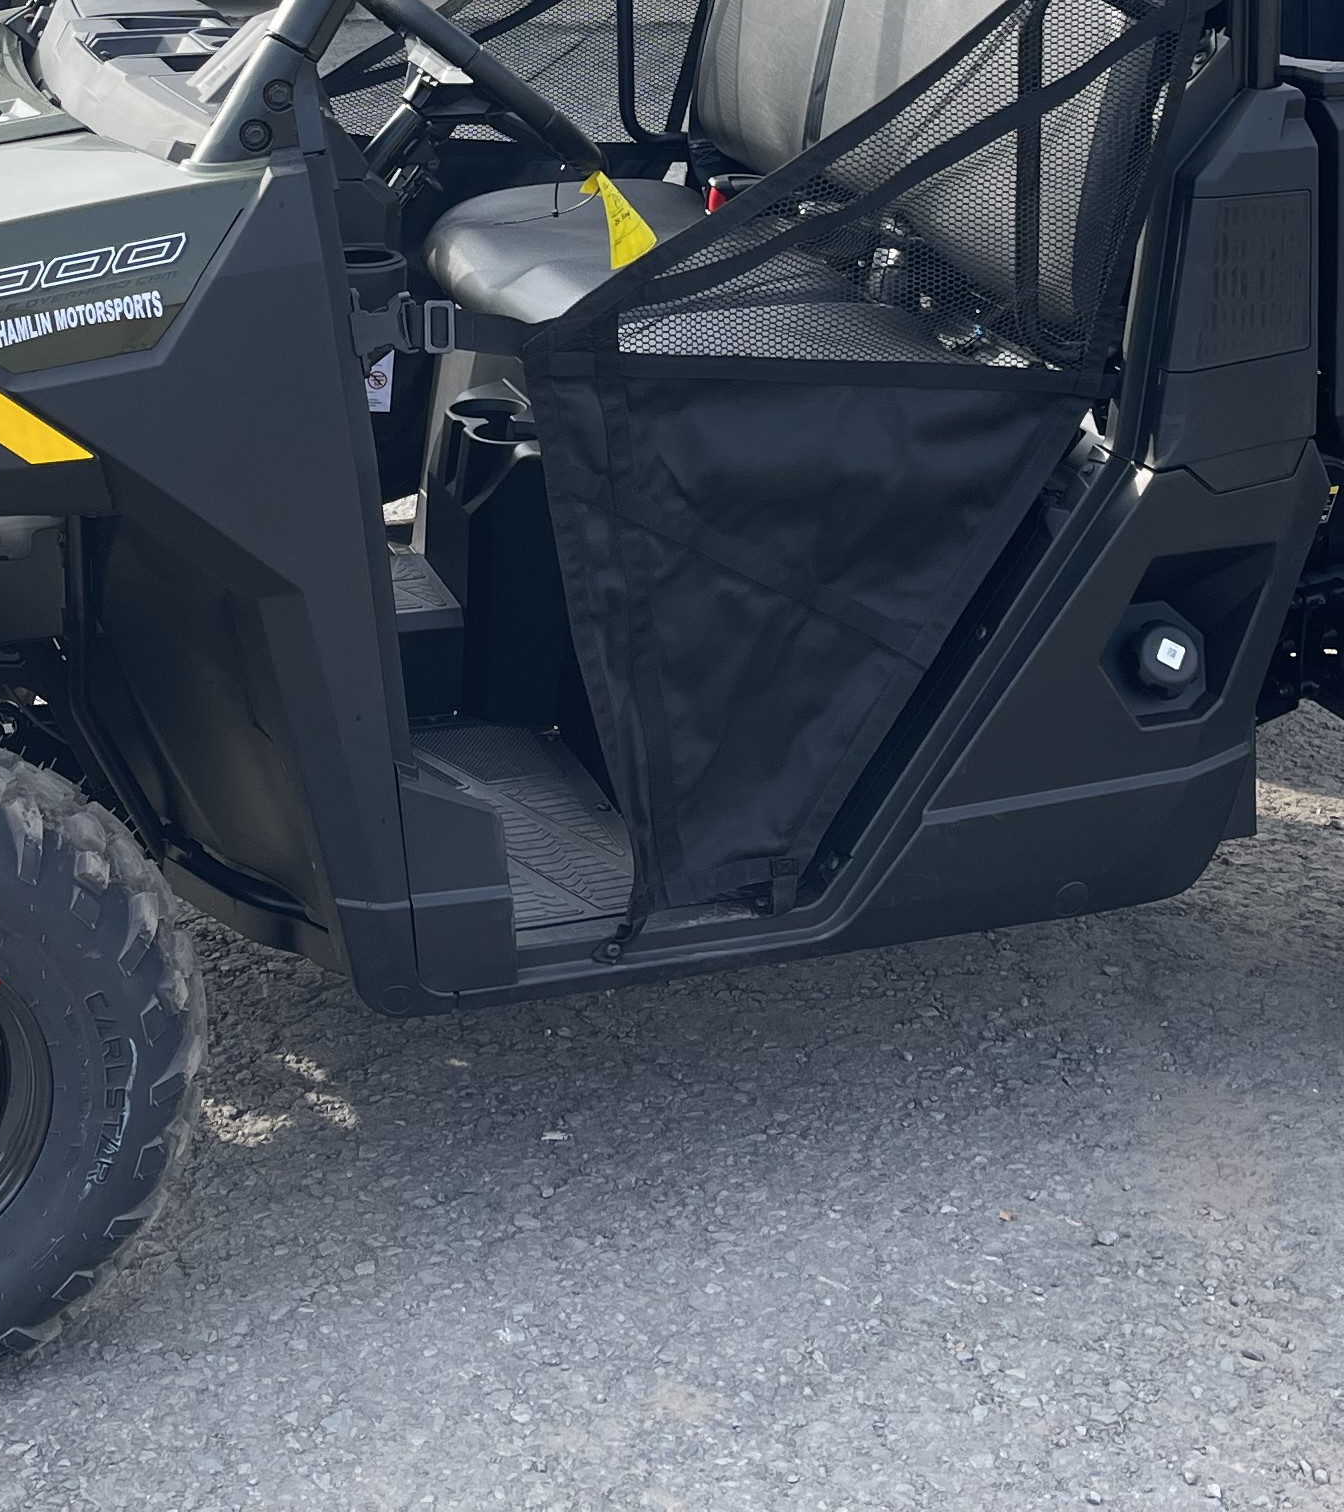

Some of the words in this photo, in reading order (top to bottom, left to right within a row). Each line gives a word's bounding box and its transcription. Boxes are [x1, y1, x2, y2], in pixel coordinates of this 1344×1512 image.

[25, 279, 132, 308] OVERHEAD
[135, 270, 179, 288] CAM
[54, 290, 164, 332] MOTORSPORTS
[83, 990, 128, 1187] CARLSTAR
